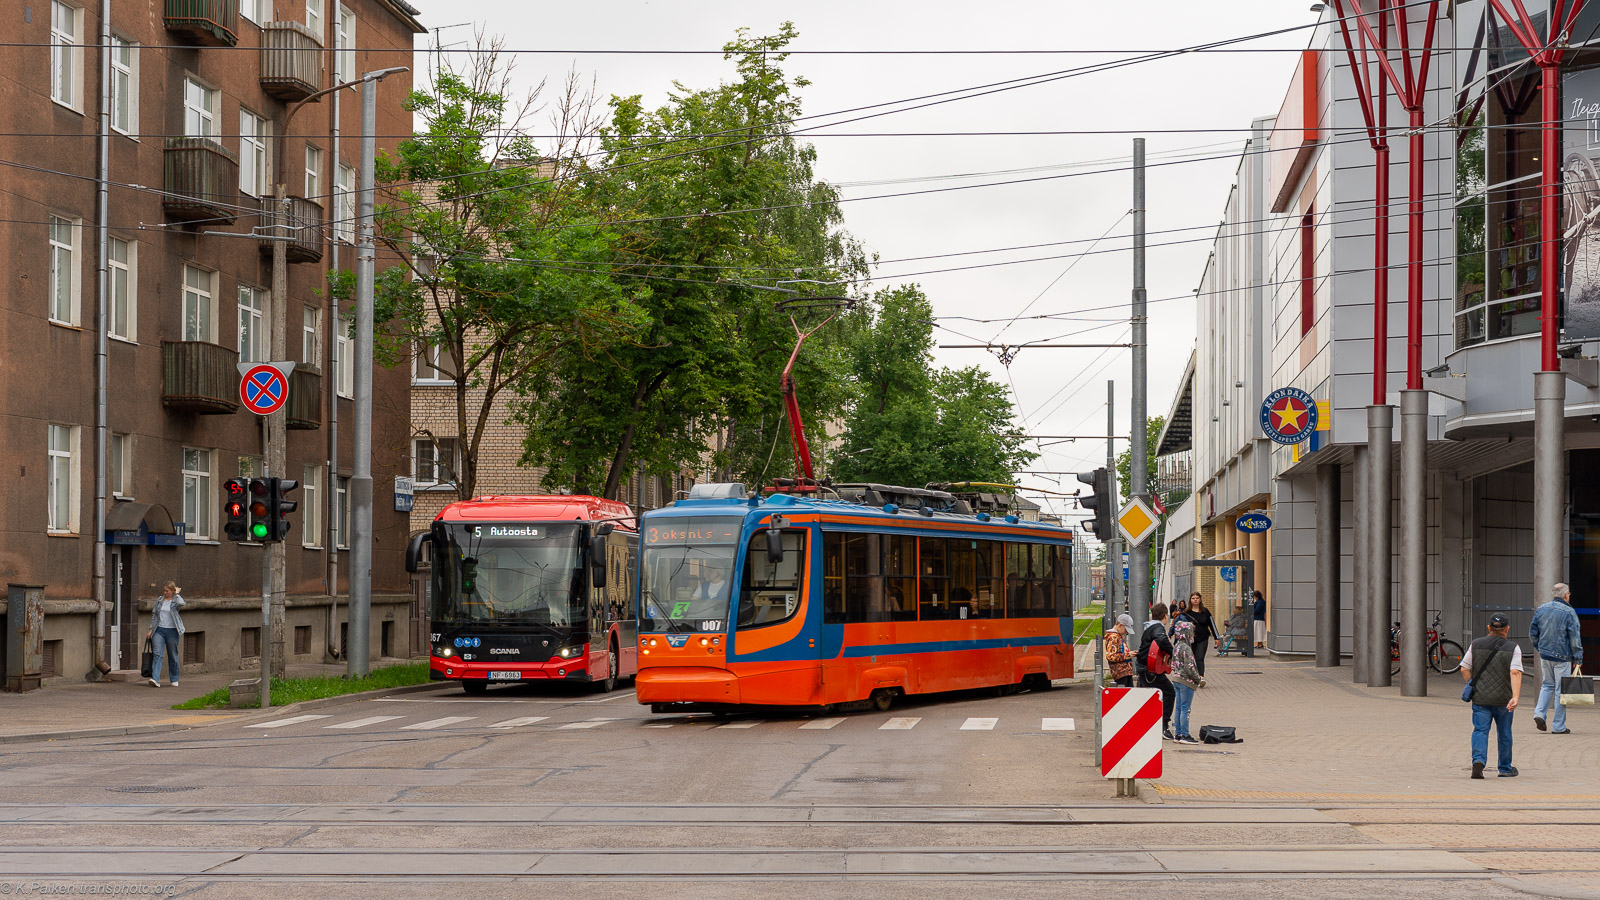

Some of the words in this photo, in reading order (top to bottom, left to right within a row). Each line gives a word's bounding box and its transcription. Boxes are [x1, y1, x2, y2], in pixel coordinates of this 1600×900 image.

[1265, 389, 1314, 409] KLONDAIKA
[475, 526, 482, 538] 5
[490, 526, 538, 536] Autoosta
[649, 528, 659, 543] 3
[702, 620, 721, 631] 007
